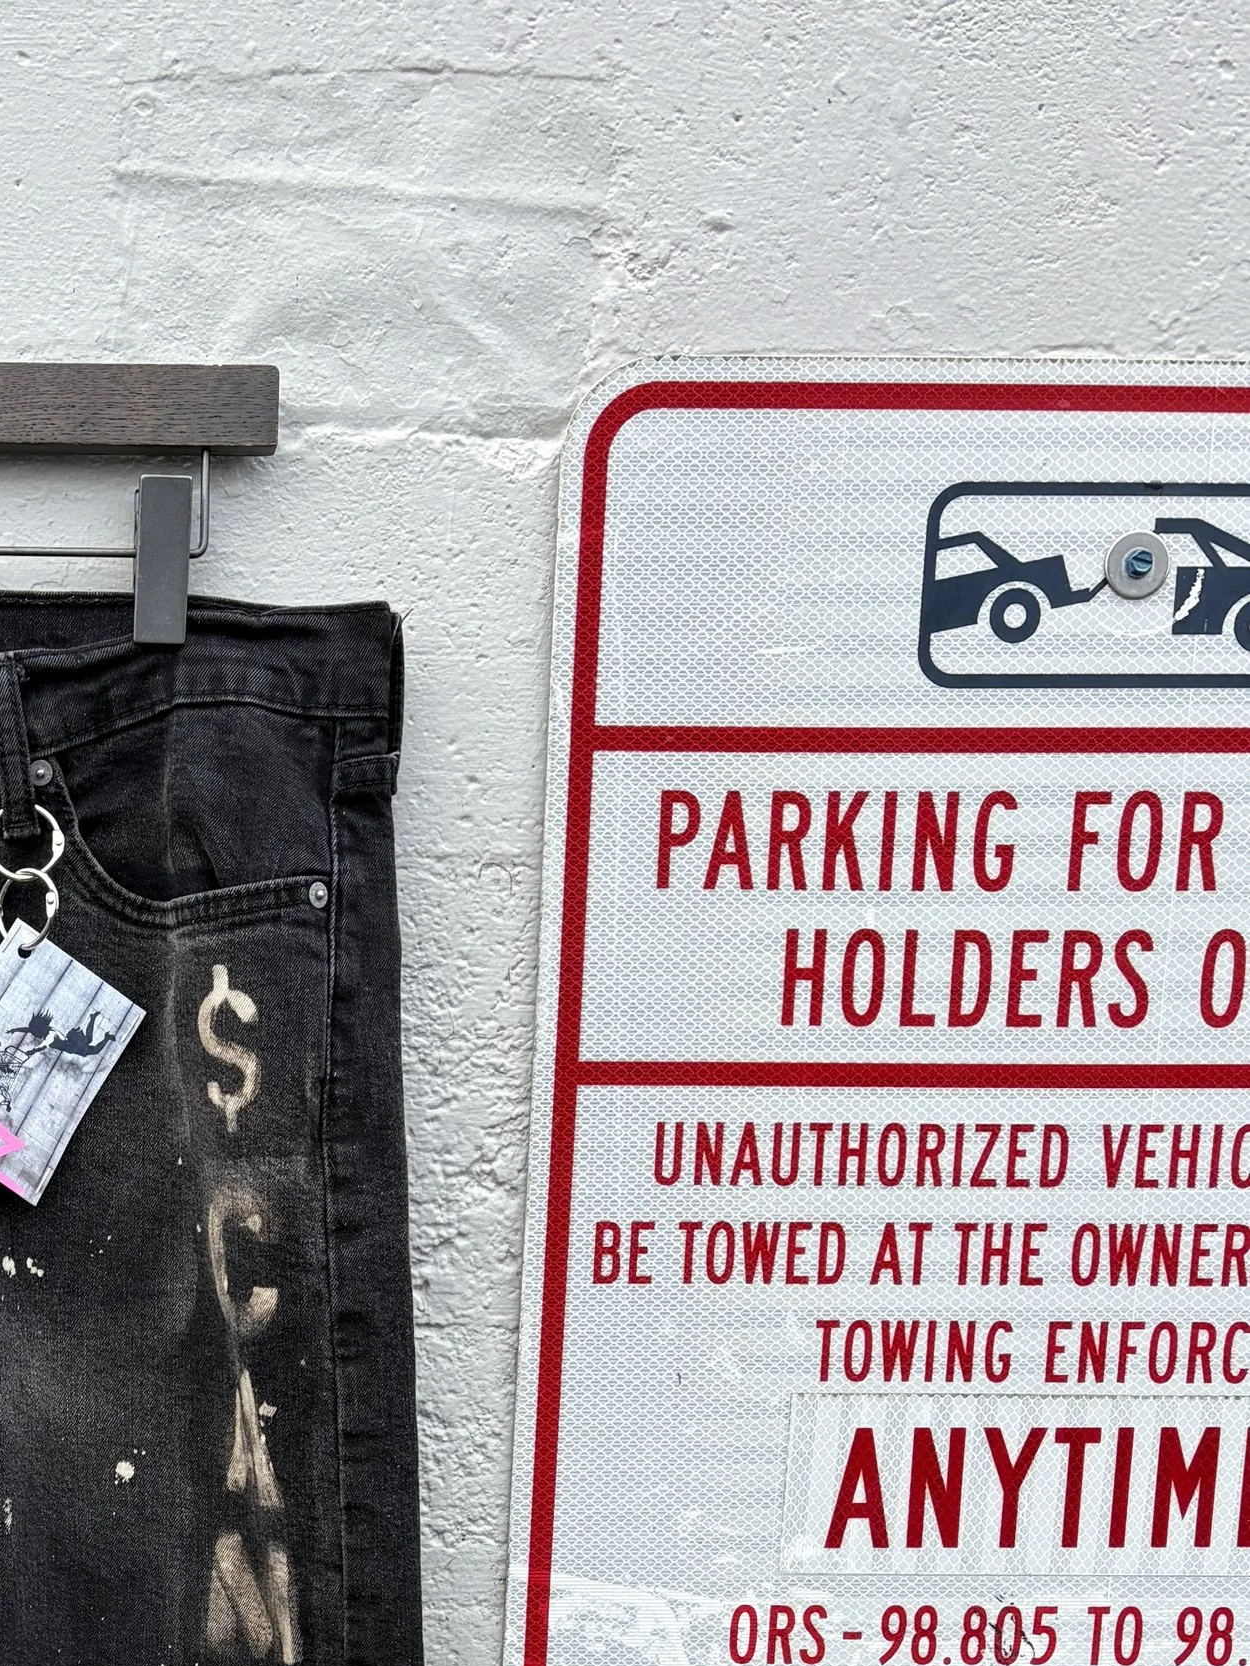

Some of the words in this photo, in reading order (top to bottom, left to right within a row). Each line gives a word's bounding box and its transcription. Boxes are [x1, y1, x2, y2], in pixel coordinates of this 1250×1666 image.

[656, 789, 1018, 893] PARKING
[1067, 790, 1224, 893] FOR
[780, 928, 1154, 1029] HOLDERS
[653, 1121, 1069, 1189] UNAUTHORIZED
[1102, 1123, 1250, 1189] VEHIC
[592, 1220, 655, 1285] BE
[678, 1221, 846, 1286] TOWED
[870, 1222, 933, 1286] AT
[954, 1222, 1048, 1287] THE
[1070, 1222, 1250, 1288] OWNER
[816, 1319, 1012, 1384] TOWING
[1044, 1321, 1250, 1385] ENFORC
[1087, 1605, 1143, 1666] TO
